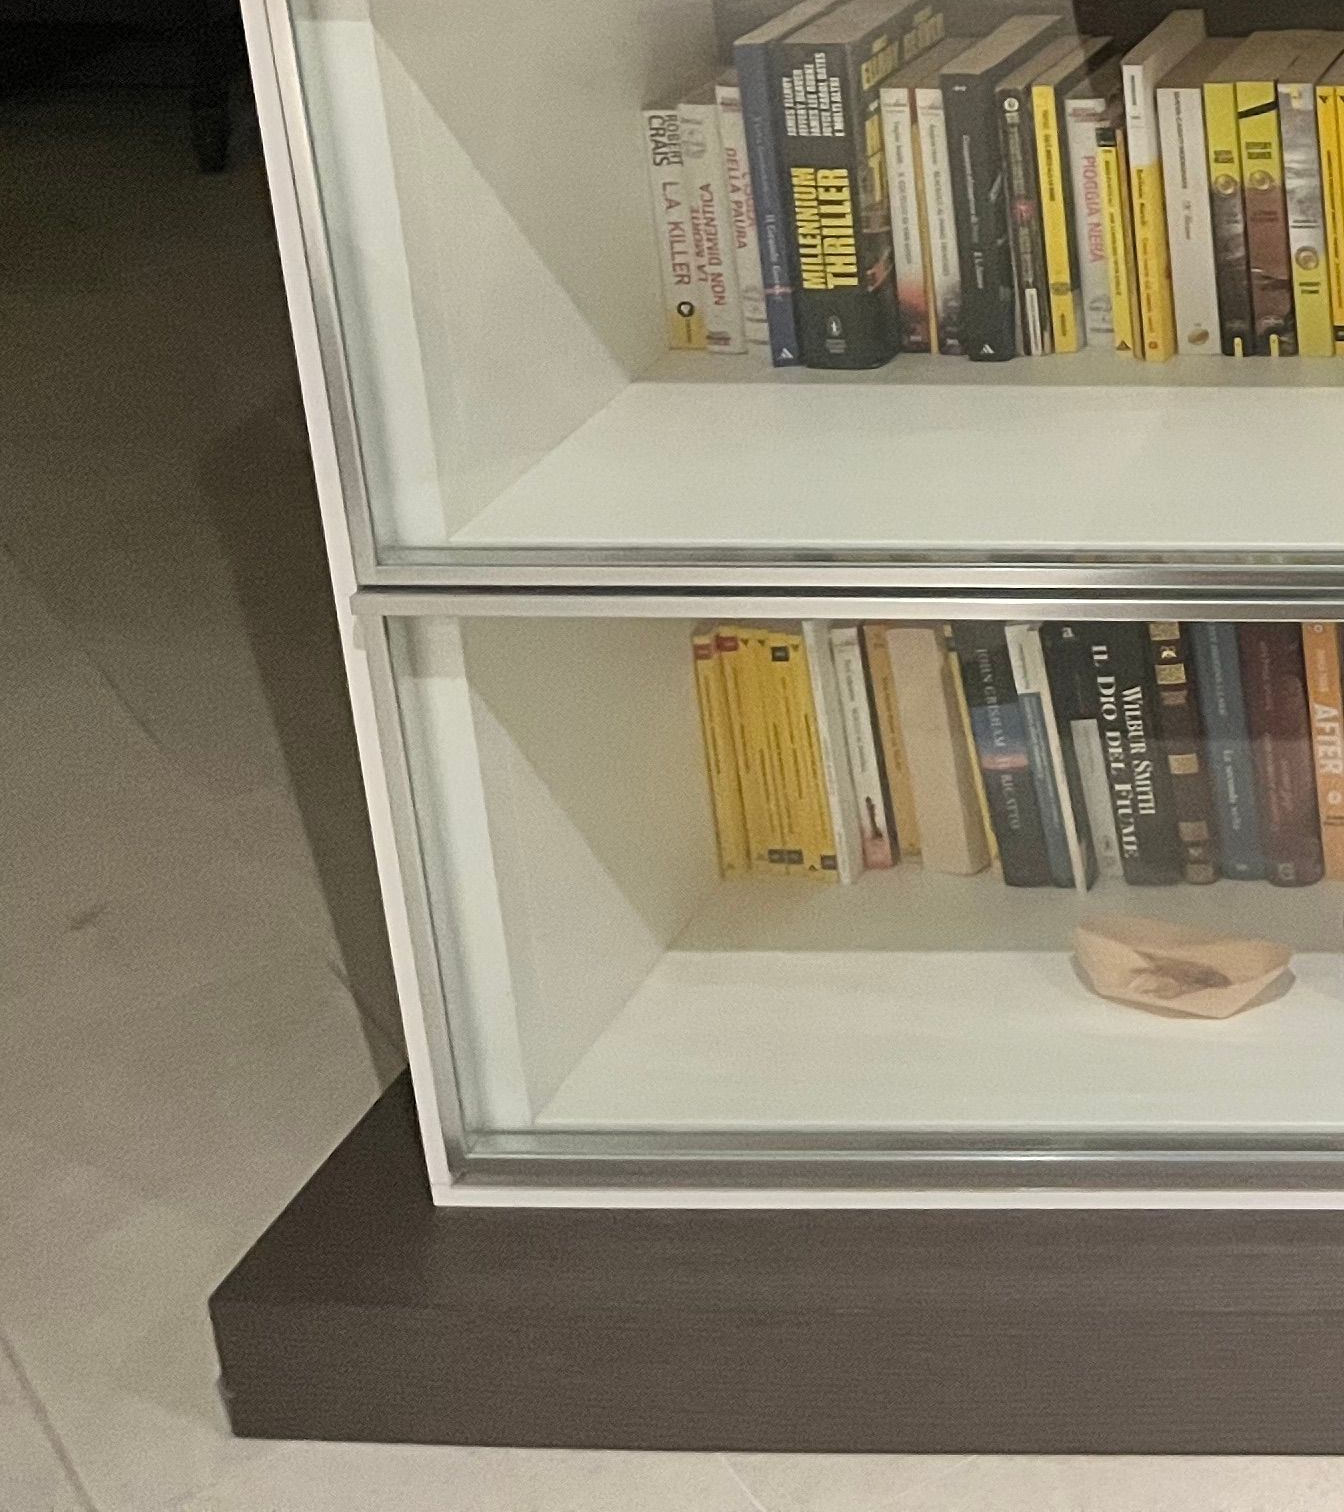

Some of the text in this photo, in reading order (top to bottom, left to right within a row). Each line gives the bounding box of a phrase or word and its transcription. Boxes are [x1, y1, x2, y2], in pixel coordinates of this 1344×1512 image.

[648, 114, 669, 167] CRAIS
[666, 114, 684, 167] ROBERT
[691, 205, 708, 283] LA MORTE
[699, 183, 726, 306] NON DIMENTICA
[724, 147, 747, 249] DELLA PAURA
[790, 167, 822, 289] MILLENNIUM
[816, 168, 859, 289] THRILLER
[1082, 155, 1105, 264] PIOGGIA NERA
[667, 220, 692, 286] KILLER
[975, 647, 1021, 830] JOHN GRISHAM RICATTO
[1091, 644, 1140, 859] IL DIO DEL FIUME
[1122, 685, 1156, 815] WILBUR SMITH
[1313, 702, 1344, 776] AFTER
